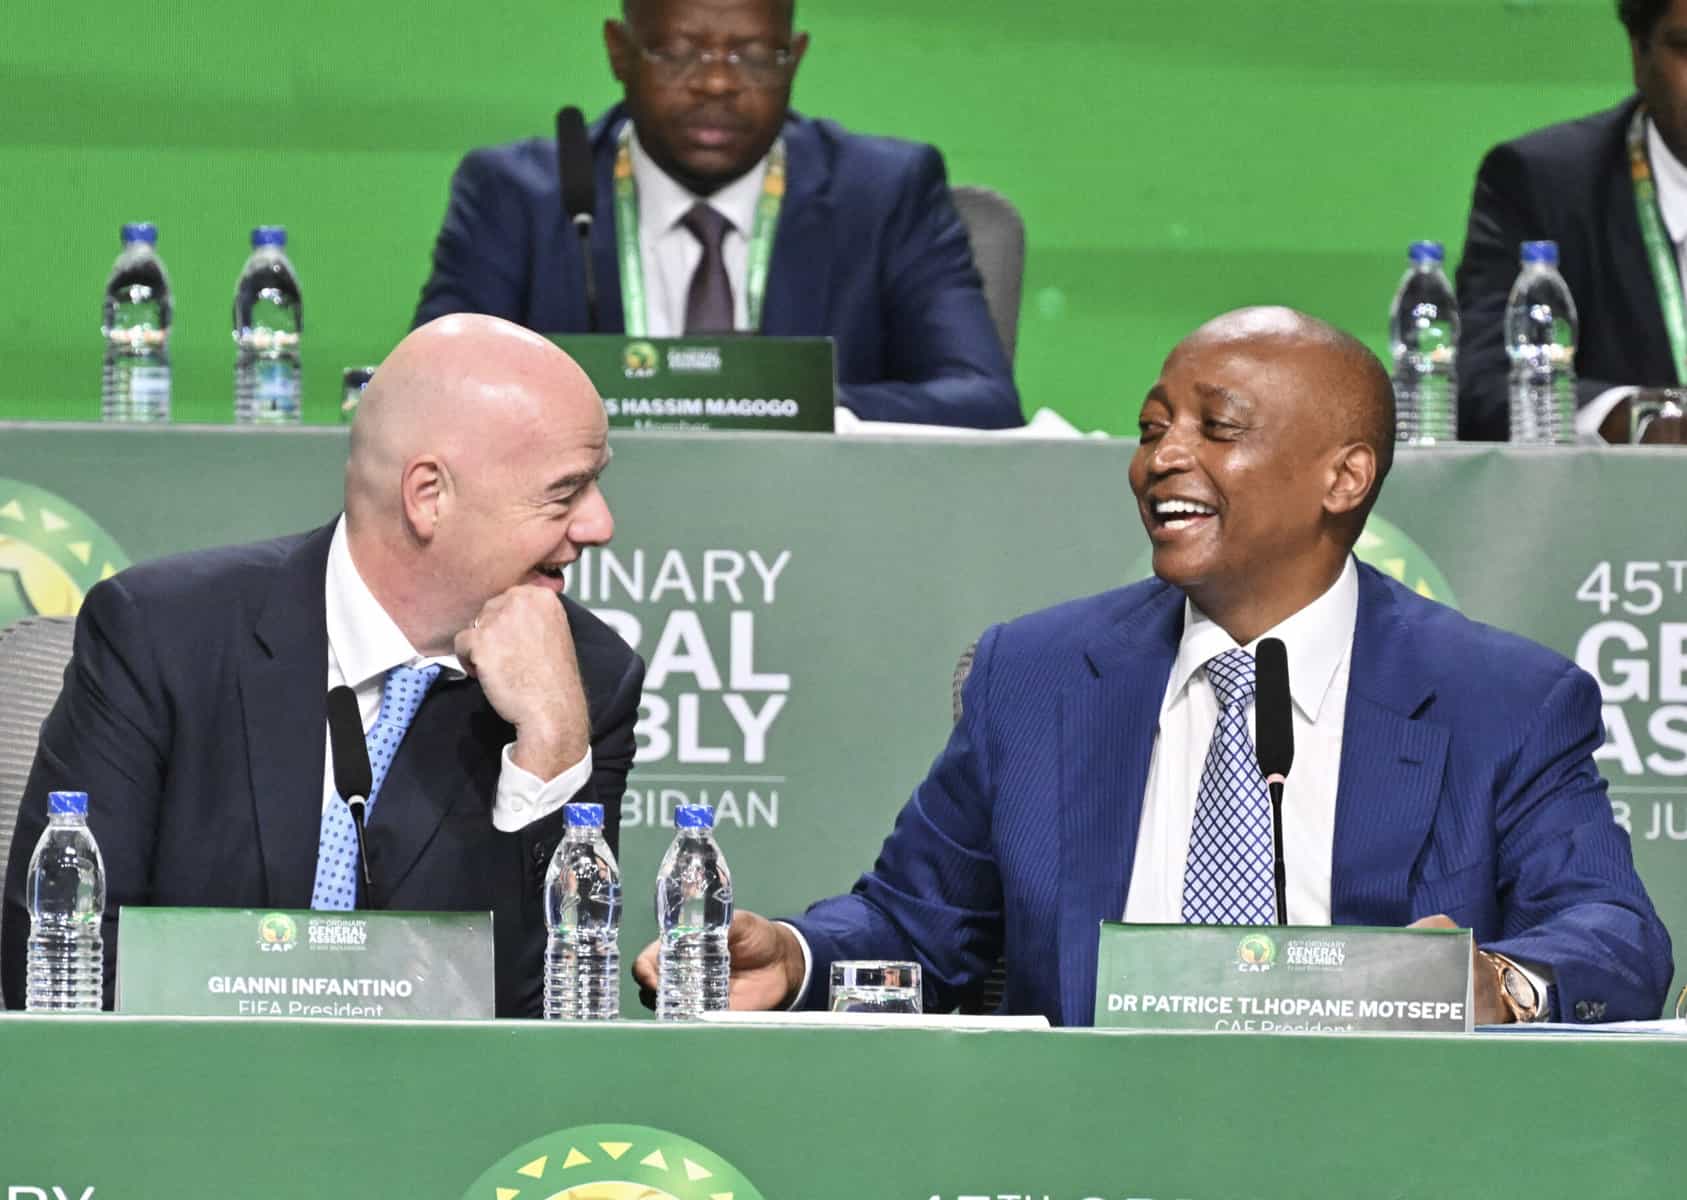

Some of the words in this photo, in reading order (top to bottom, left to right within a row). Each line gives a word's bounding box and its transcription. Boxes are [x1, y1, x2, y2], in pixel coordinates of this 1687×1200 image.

[621, 398, 701, 416] HASSIM
[705, 399, 799, 417] MAGOGO
[563, 548, 792, 604] INARY
[208, 976, 287, 994] GIANNI
[291, 977, 412, 997] INFANTINO
[239, 1000, 282, 1015] FIFA
[289, 1001, 384, 1017] President
[1107, 994, 1137, 1012] DR
[1142, 994, 1232, 1014] PATRICE
[1238, 997, 1354, 1017] TLHOPANE
[1359, 1001, 1464, 1020] MOTSEPE
